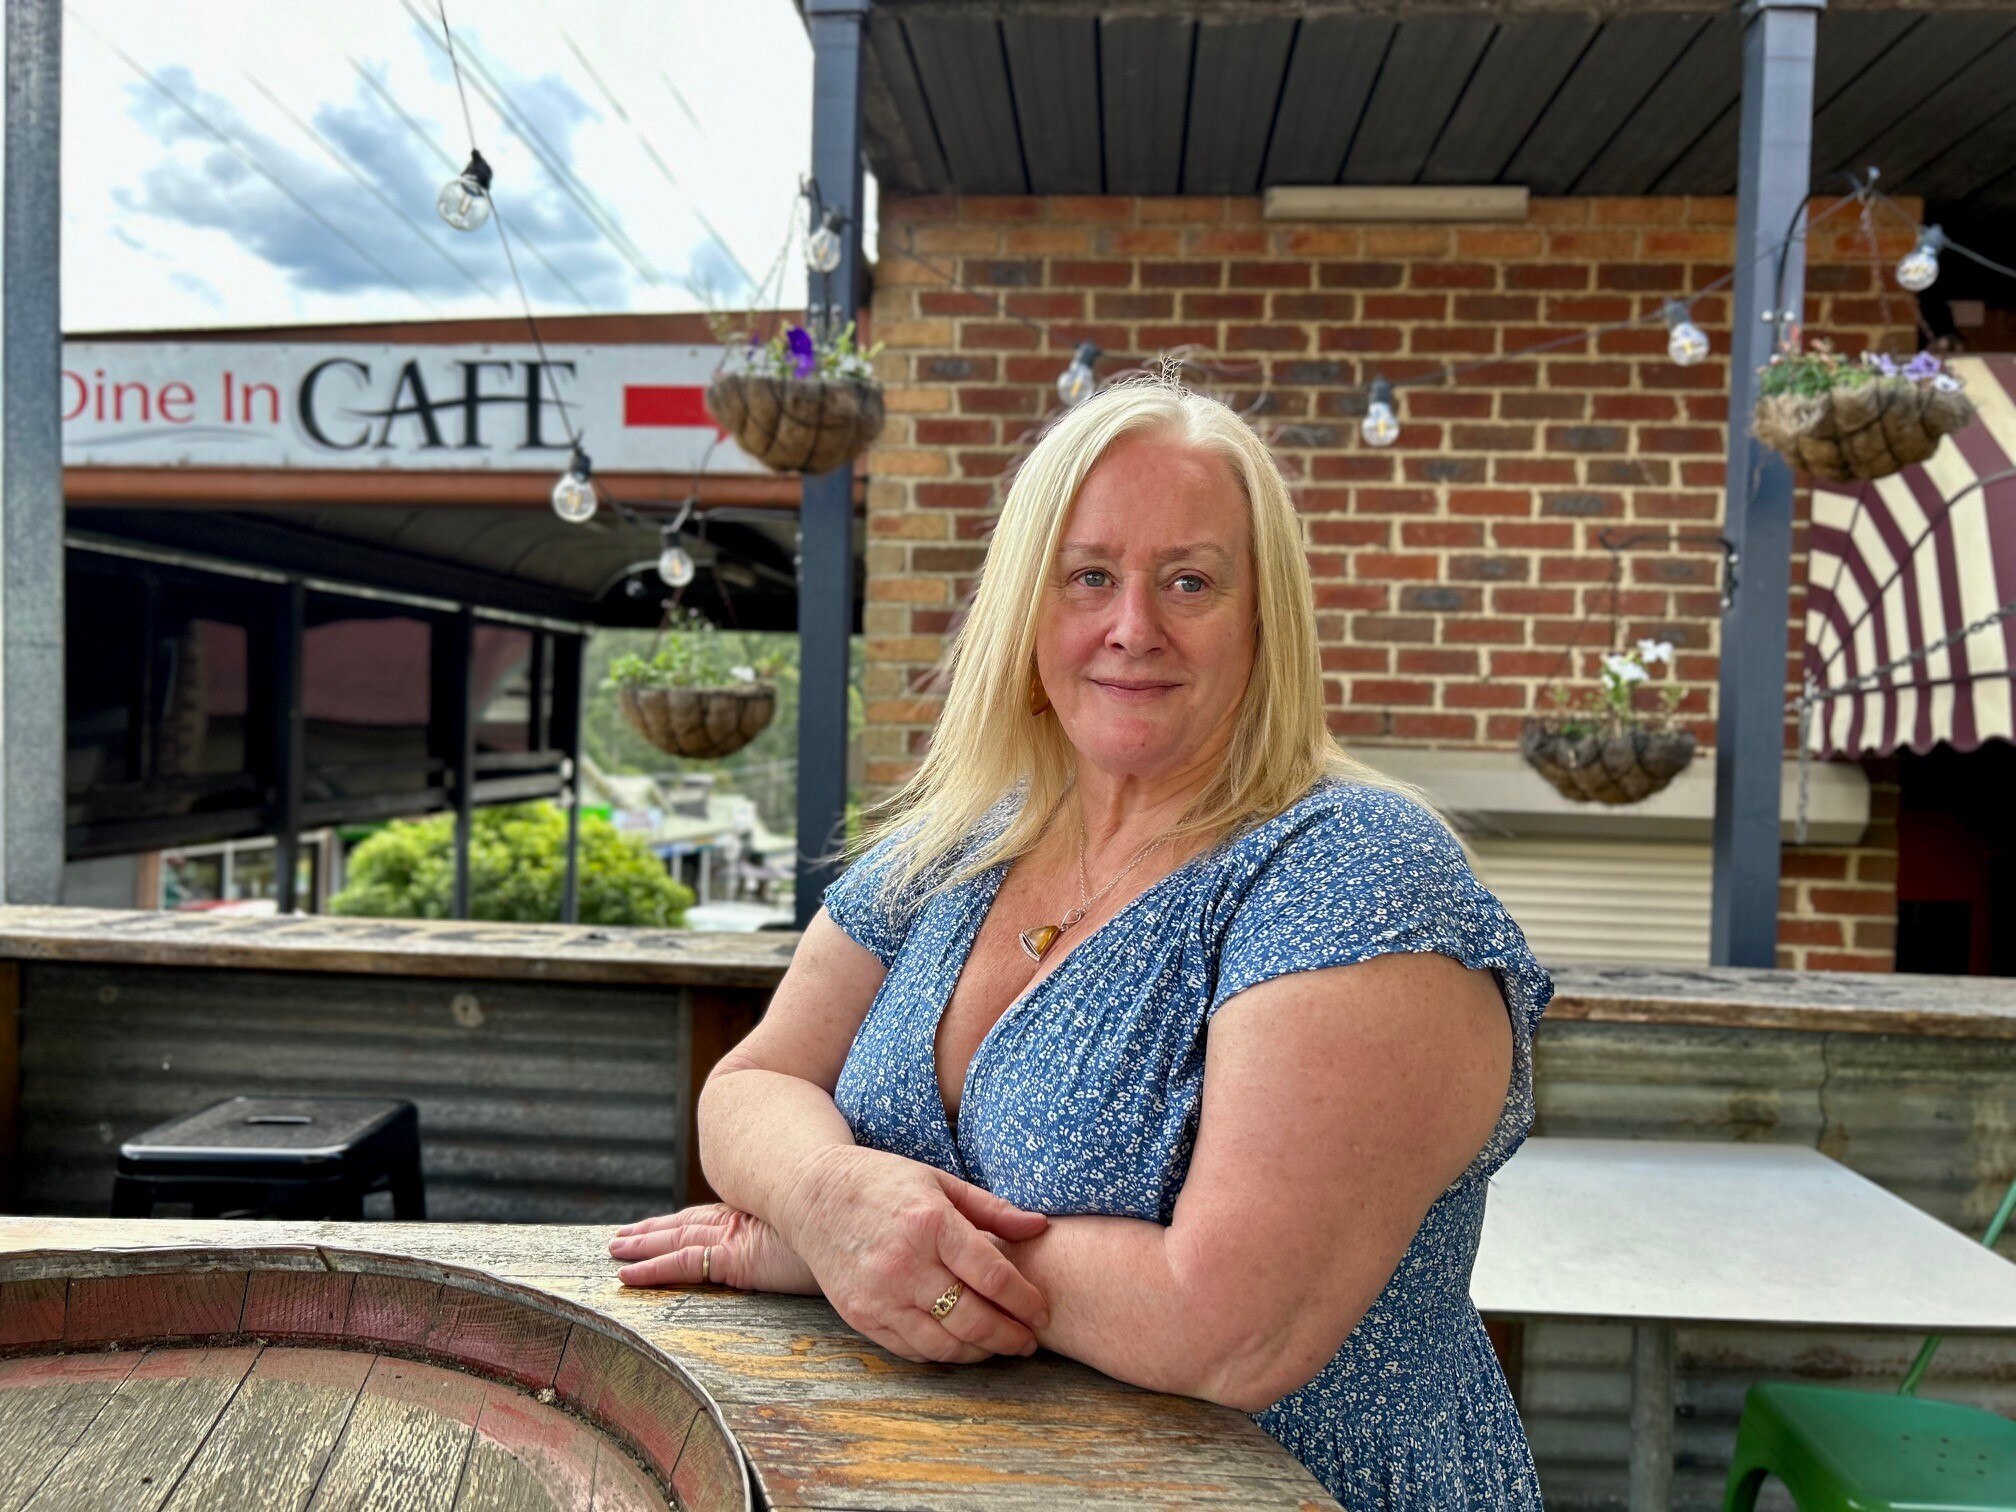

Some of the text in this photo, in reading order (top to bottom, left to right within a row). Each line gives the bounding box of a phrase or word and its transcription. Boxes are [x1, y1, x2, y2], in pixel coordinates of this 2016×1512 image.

[60, 356, 579, 451] Dine In CAFE
